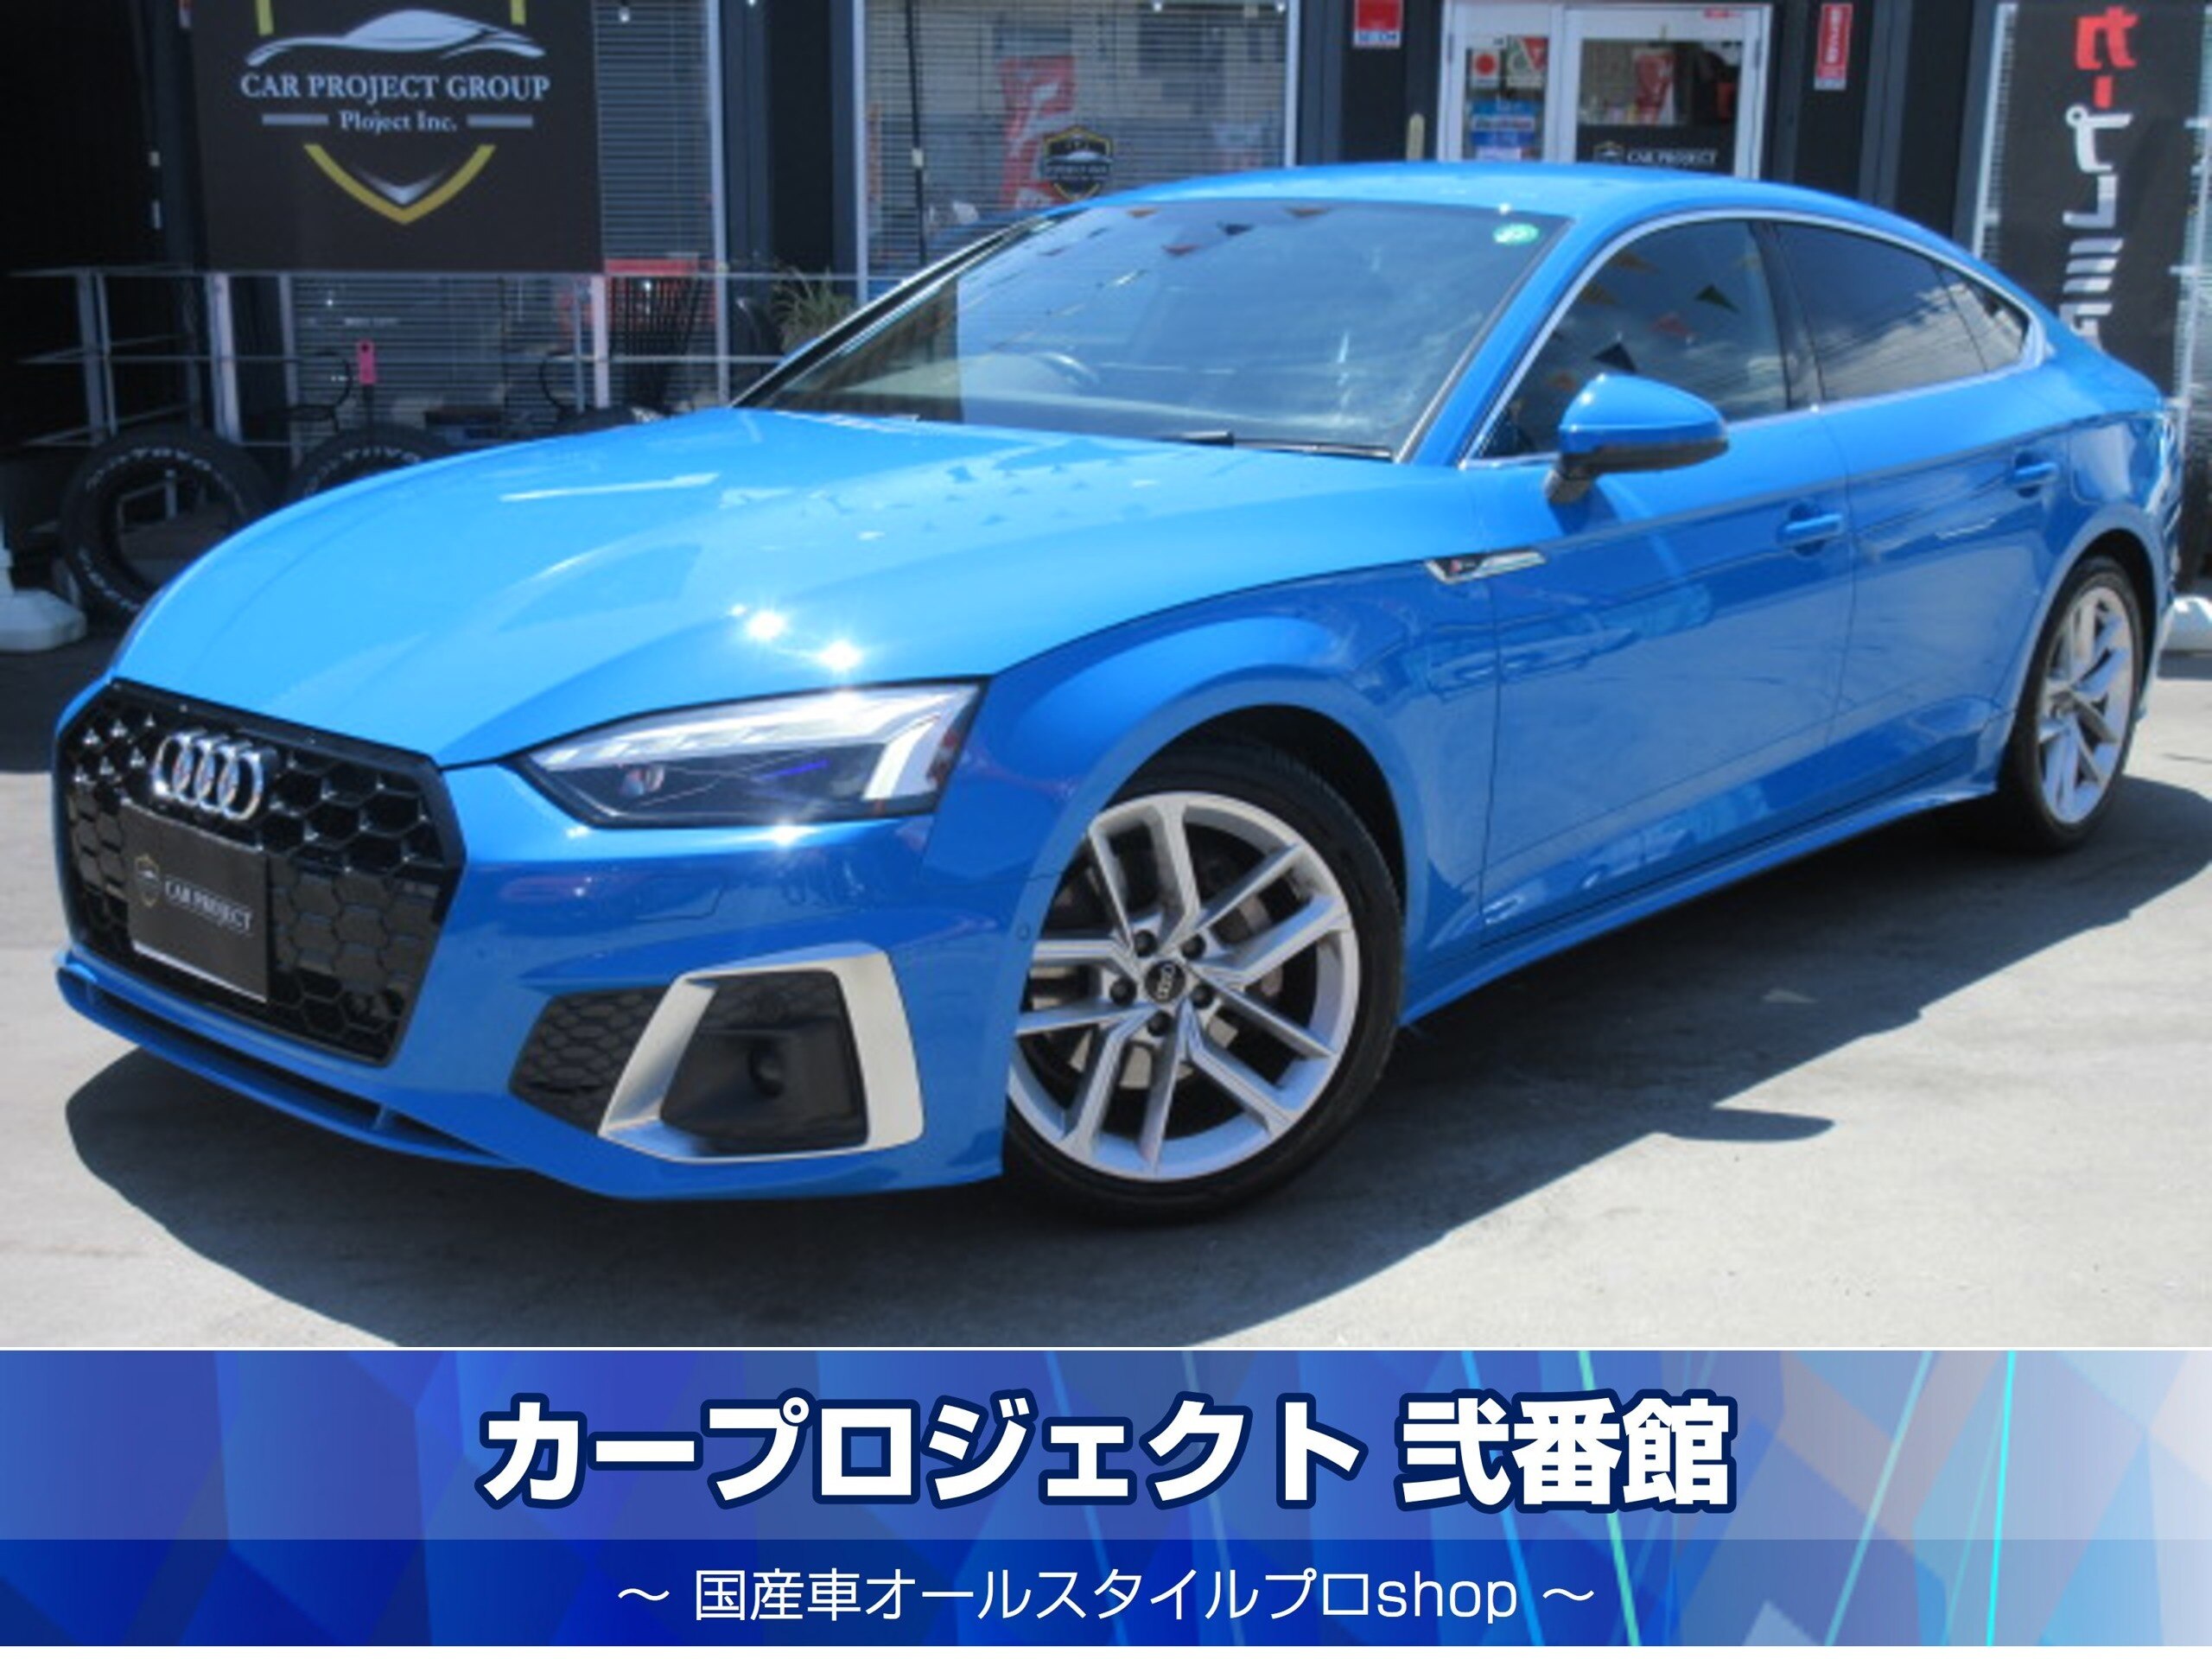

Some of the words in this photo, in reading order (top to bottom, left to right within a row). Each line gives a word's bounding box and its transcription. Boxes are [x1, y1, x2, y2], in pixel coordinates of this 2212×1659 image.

[240, 73, 302, 98] CAR
[307, 74, 440, 105] PROJECT
[446, 75, 550, 100] GROUP
[416, 111, 458, 131] Inc.
[165, 880, 191, 904] CAR
[193, 890, 252, 932] PROJECT
